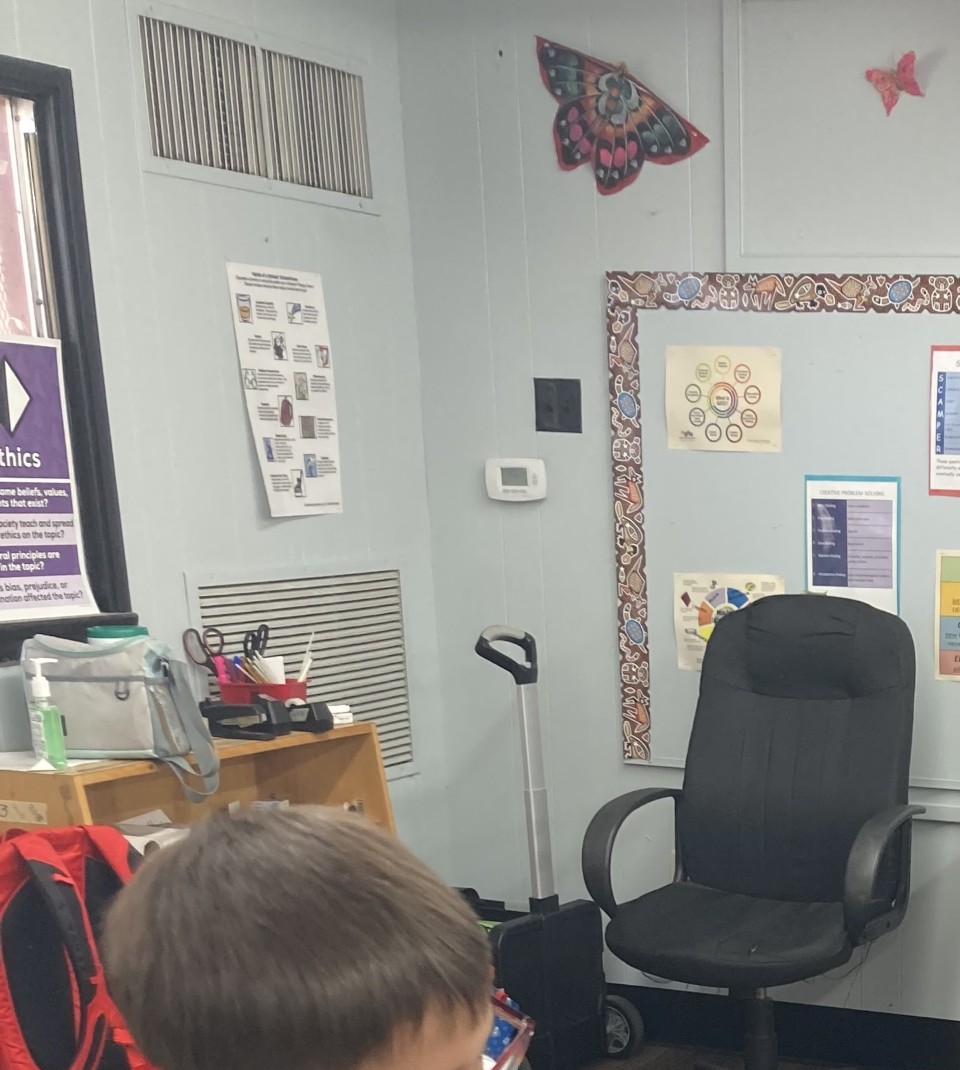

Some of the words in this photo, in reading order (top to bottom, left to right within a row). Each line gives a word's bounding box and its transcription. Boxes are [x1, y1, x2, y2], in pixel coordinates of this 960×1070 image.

[0, 446, 41, 468] thics
[16, 487, 43, 497] beliefs,
[44, 488, 68, 497] values,
[10, 499, 26, 508] that
[28, 498, 48, 508] exist?
[20, 520, 38, 528] teach
[38, 519, 51, 528] and
[52, 520, 74, 530] spread
[1, 530, 20, 539] ethics
[32, 530, 43, 538] the
[44, 530, 64, 540] topic?
[12, 550, 46, 561] principles
[8, 562, 21, 571] the
[22, 561, 44, 572] topic?
[24, 592, 52, 602] affected
[64, 590, 83, 600] topic?
